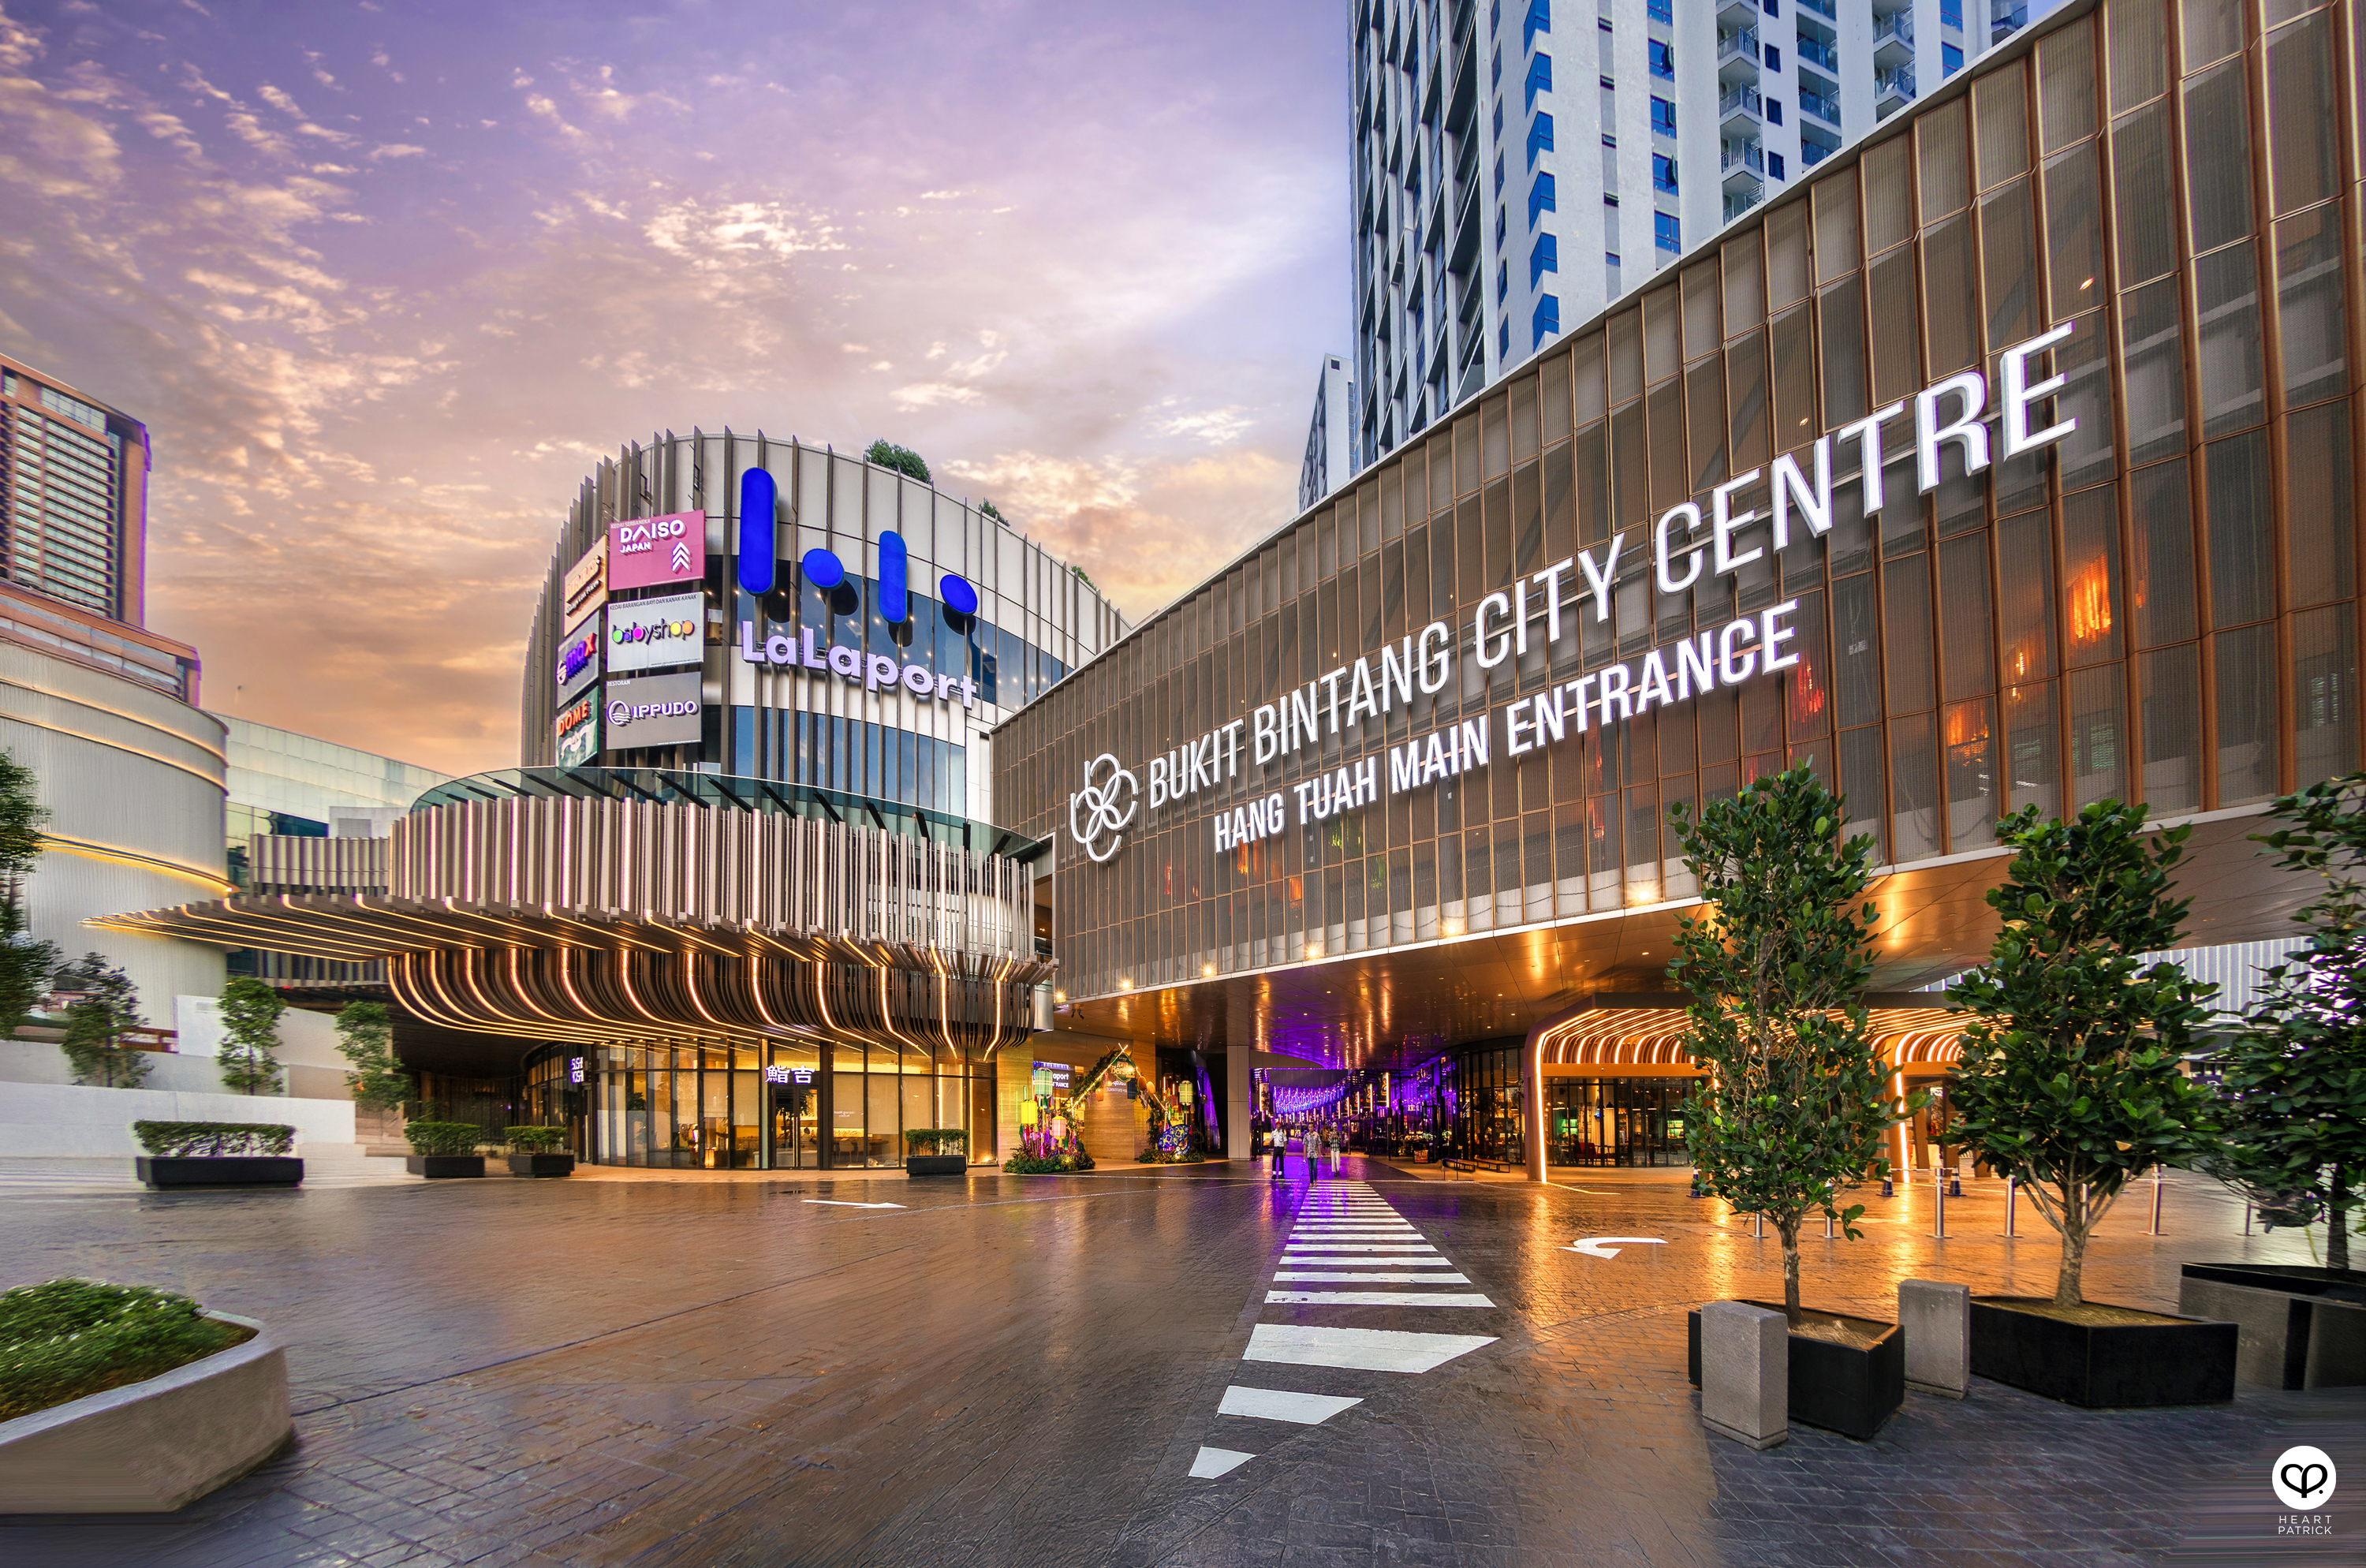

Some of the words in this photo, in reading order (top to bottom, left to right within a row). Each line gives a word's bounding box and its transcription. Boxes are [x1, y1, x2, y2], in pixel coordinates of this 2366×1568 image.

[619, 519, 685, 544] DAISO
[619, 541, 652, 554] JAPAN
[1149, 719, 1244, 809] BUKIT
[1254, 621, 1449, 766] BINTANG
[1475, 532, 1625, 670] CITY
[1656, 321, 2077, 595] CENTRE
[665, 594, 697, 603] KANAK-KANAK
[612, 618, 695, 646] babyshop
[741, 621, 977, 710] LaLaport
[632, 700, 698, 719] IPPUDO
[1215, 793, 1284, 853] HANG
[1293, 756, 1377, 826] TUAH
[1390, 715, 1489, 795] MAIN
[1506, 599, 1800, 757] ENTRANCE
[765, 1065, 815, 1085] 鮨吉
